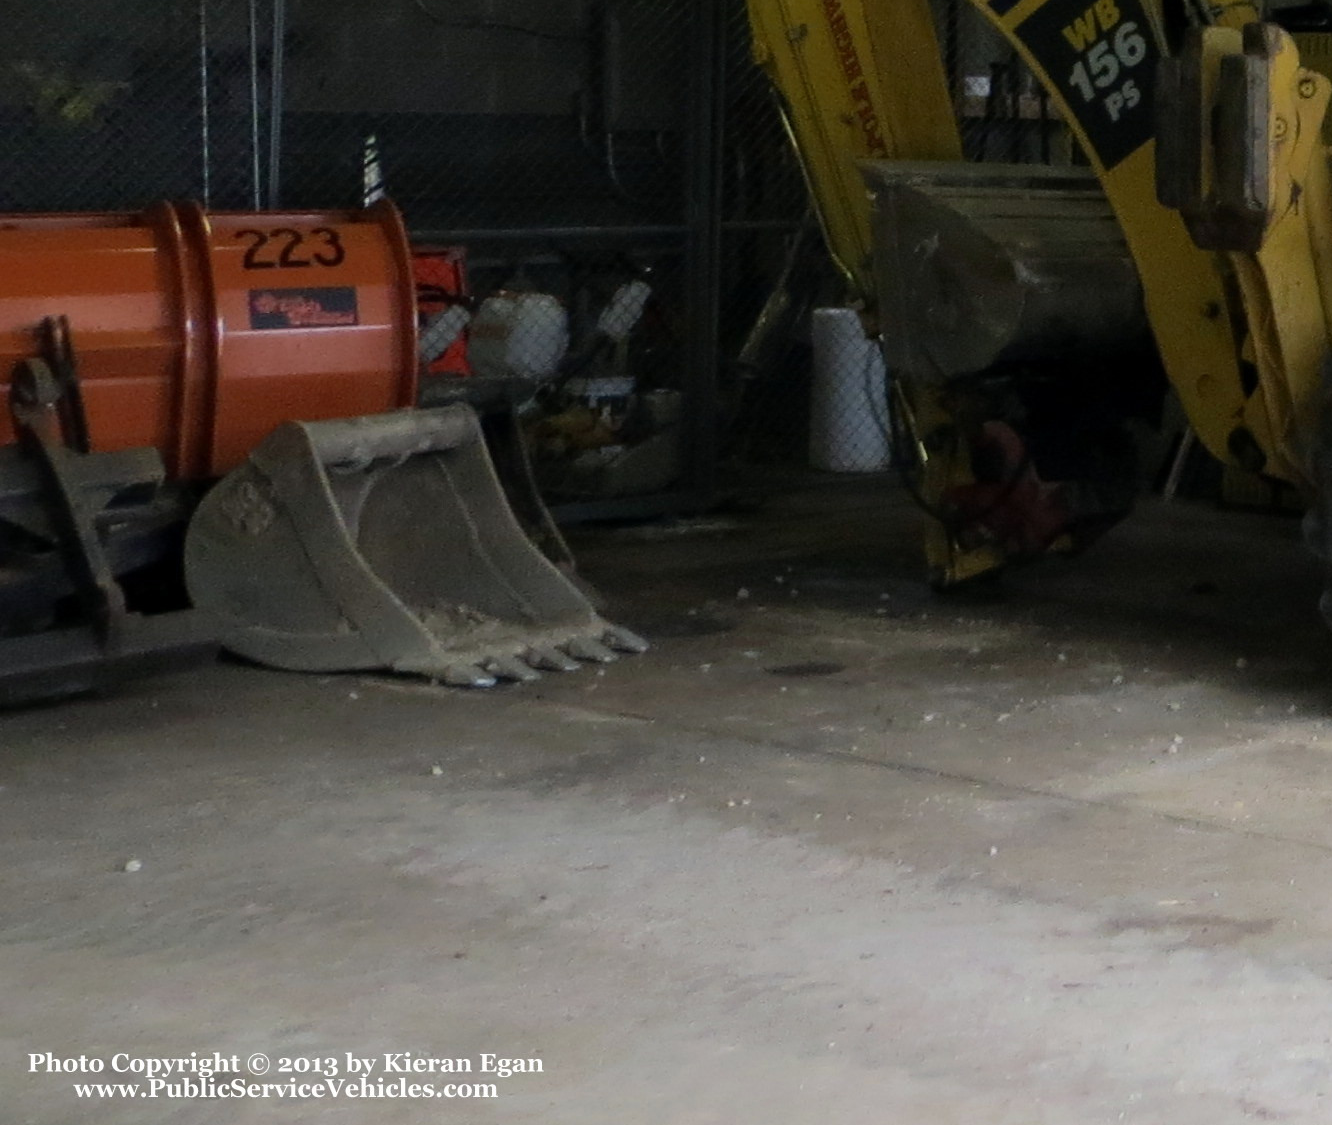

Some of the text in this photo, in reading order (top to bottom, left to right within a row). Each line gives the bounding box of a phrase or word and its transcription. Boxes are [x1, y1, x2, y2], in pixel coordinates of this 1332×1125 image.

[1068, 21, 1146, 102] 156
[1103, 79, 1141, 122] PS
[234, 228, 346, 269] 223
